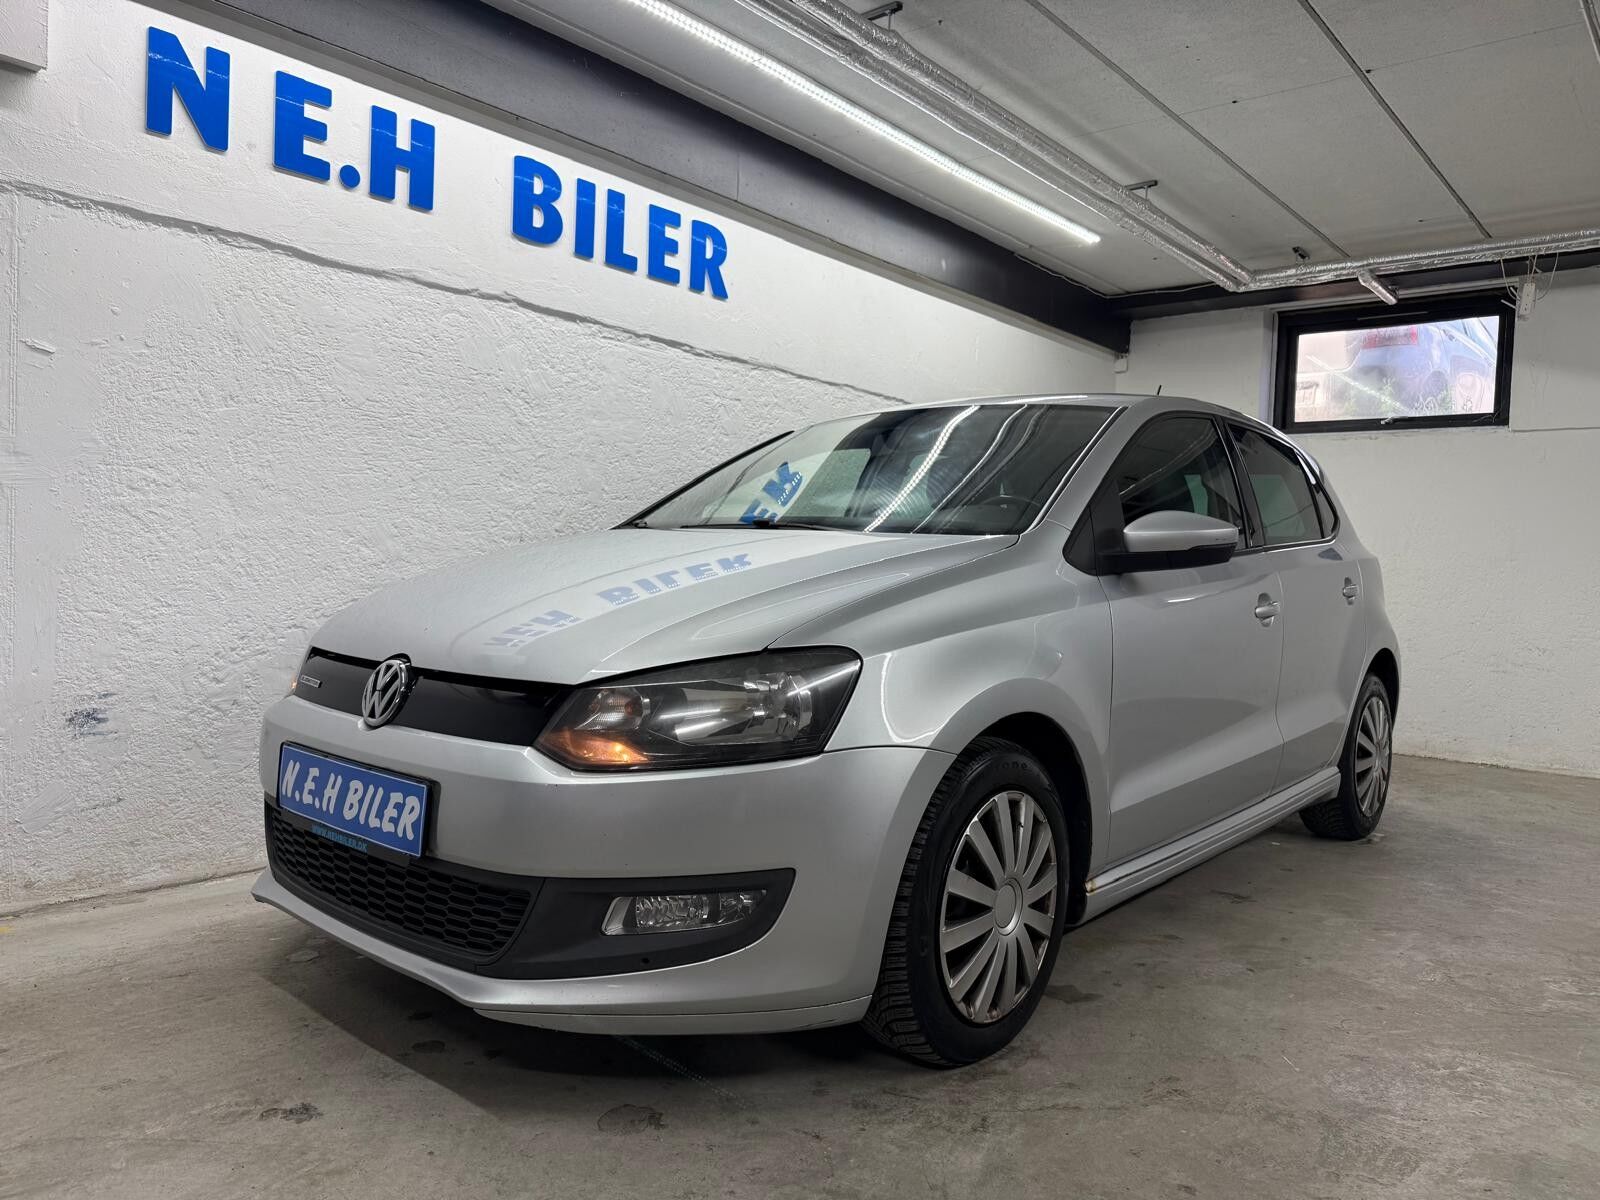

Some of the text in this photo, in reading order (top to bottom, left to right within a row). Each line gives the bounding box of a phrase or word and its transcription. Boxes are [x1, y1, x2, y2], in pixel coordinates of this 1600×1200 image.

[511, 154, 729, 300] BILER
[282, 759, 421, 841] N.E.H BILER
